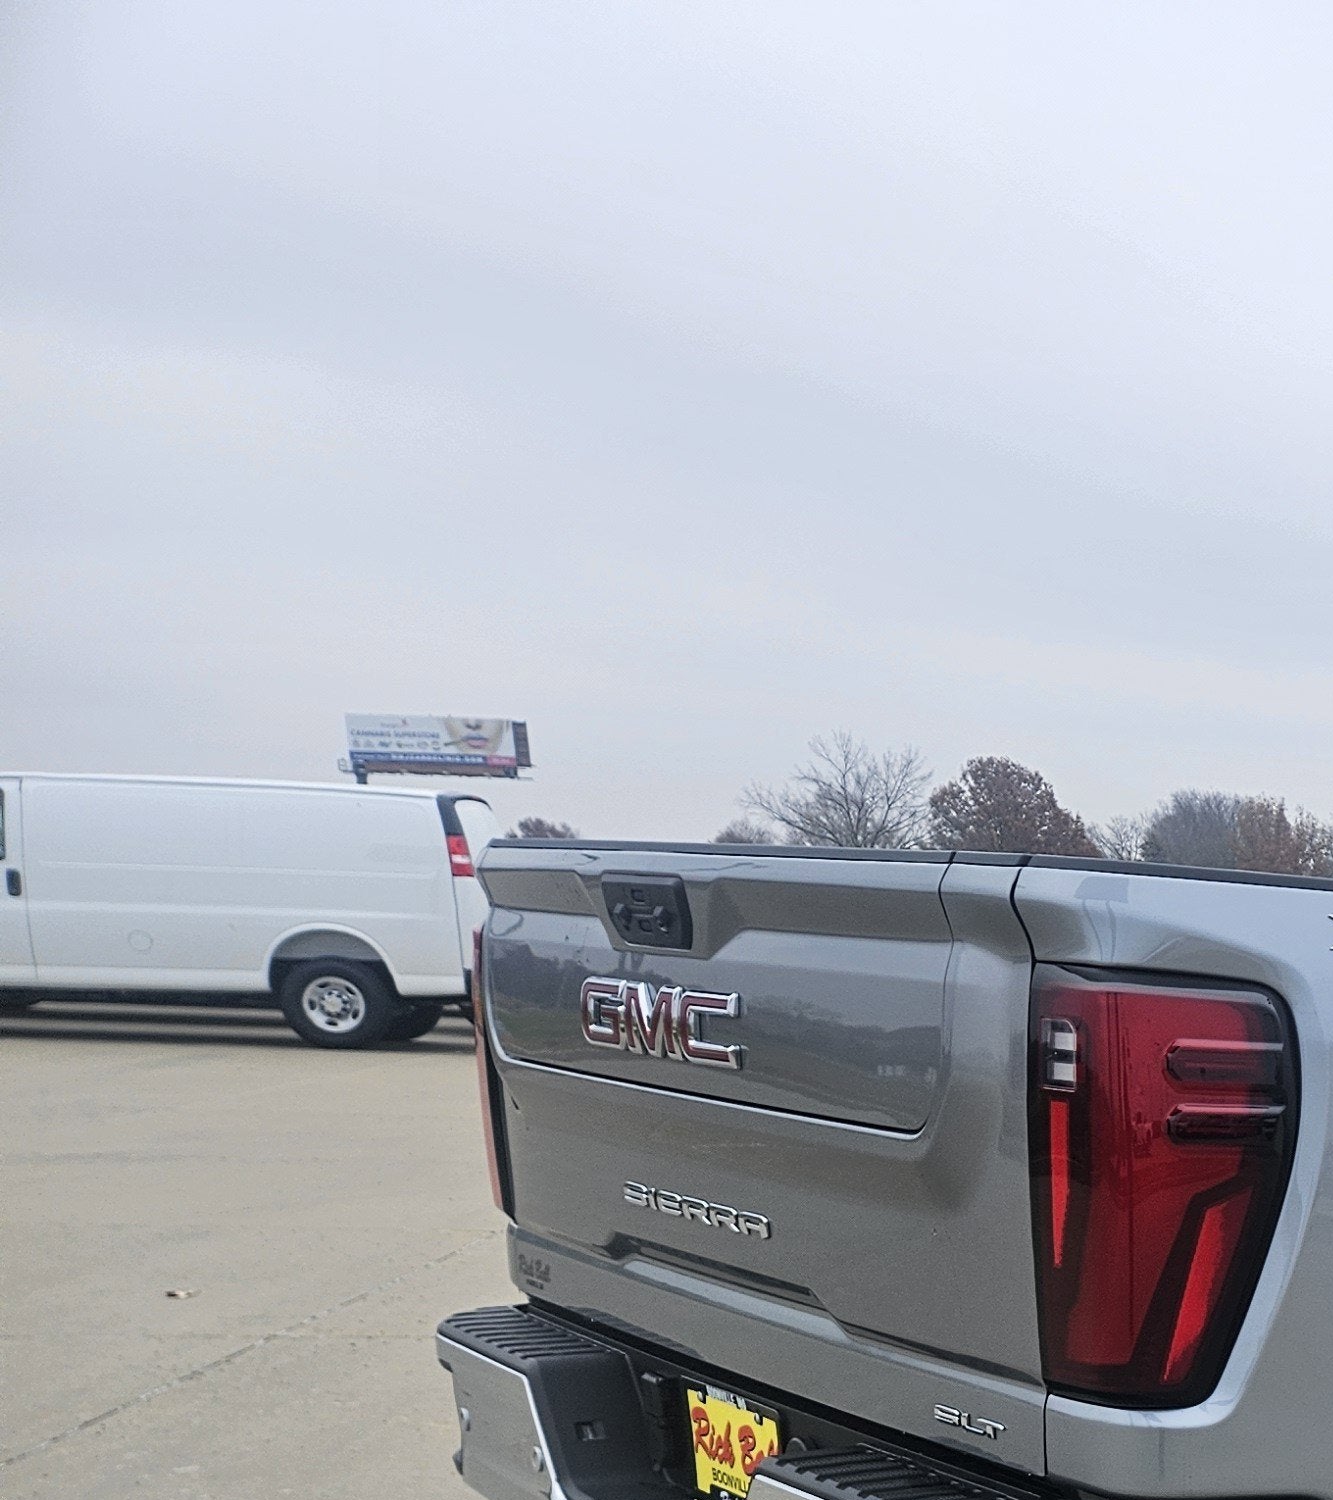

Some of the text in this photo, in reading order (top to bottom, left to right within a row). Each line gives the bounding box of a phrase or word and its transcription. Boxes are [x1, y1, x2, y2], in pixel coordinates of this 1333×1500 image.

[580, 975, 744, 1071] GMC
[623, 1179, 772, 1240] SIERRA
[692, 1406, 735, 1469] Rick
[933, 1403, 1007, 1440] SLT
